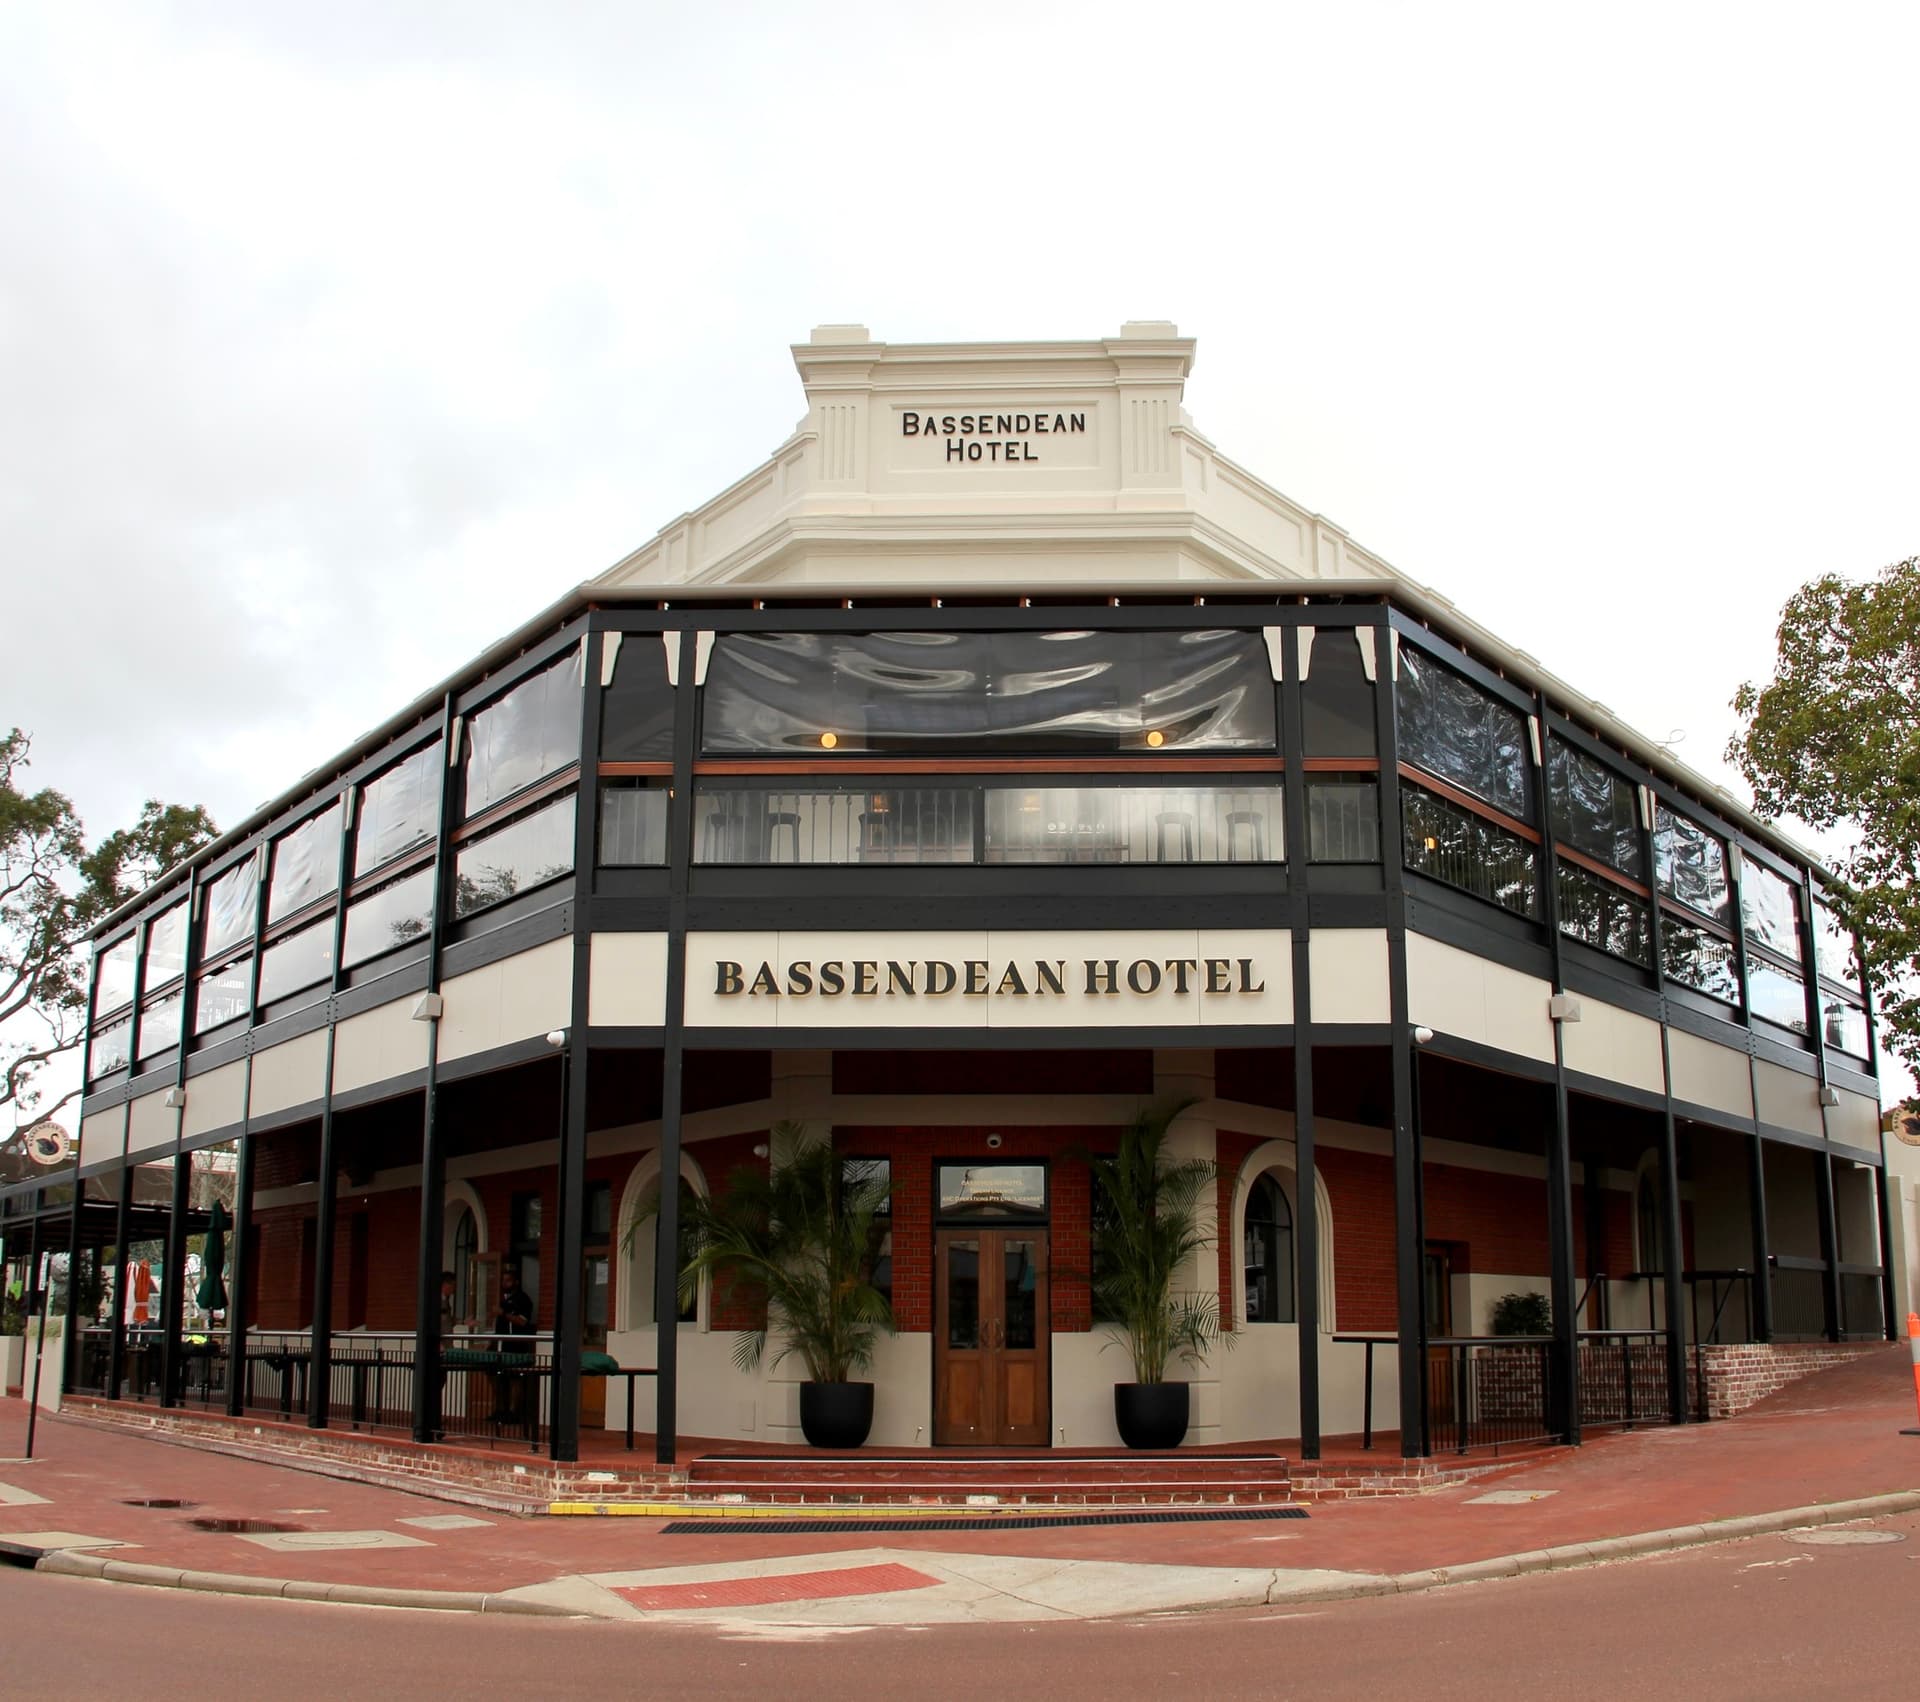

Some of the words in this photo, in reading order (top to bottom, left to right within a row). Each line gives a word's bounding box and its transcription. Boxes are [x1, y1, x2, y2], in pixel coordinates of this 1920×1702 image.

[903, 412, 1086, 436] BASSENDEAN
[946, 438, 1039, 462] HOTEL
[713, 960, 1066, 996] BASSENDEAN
[1083, 959, 1265, 995] HOTEL
